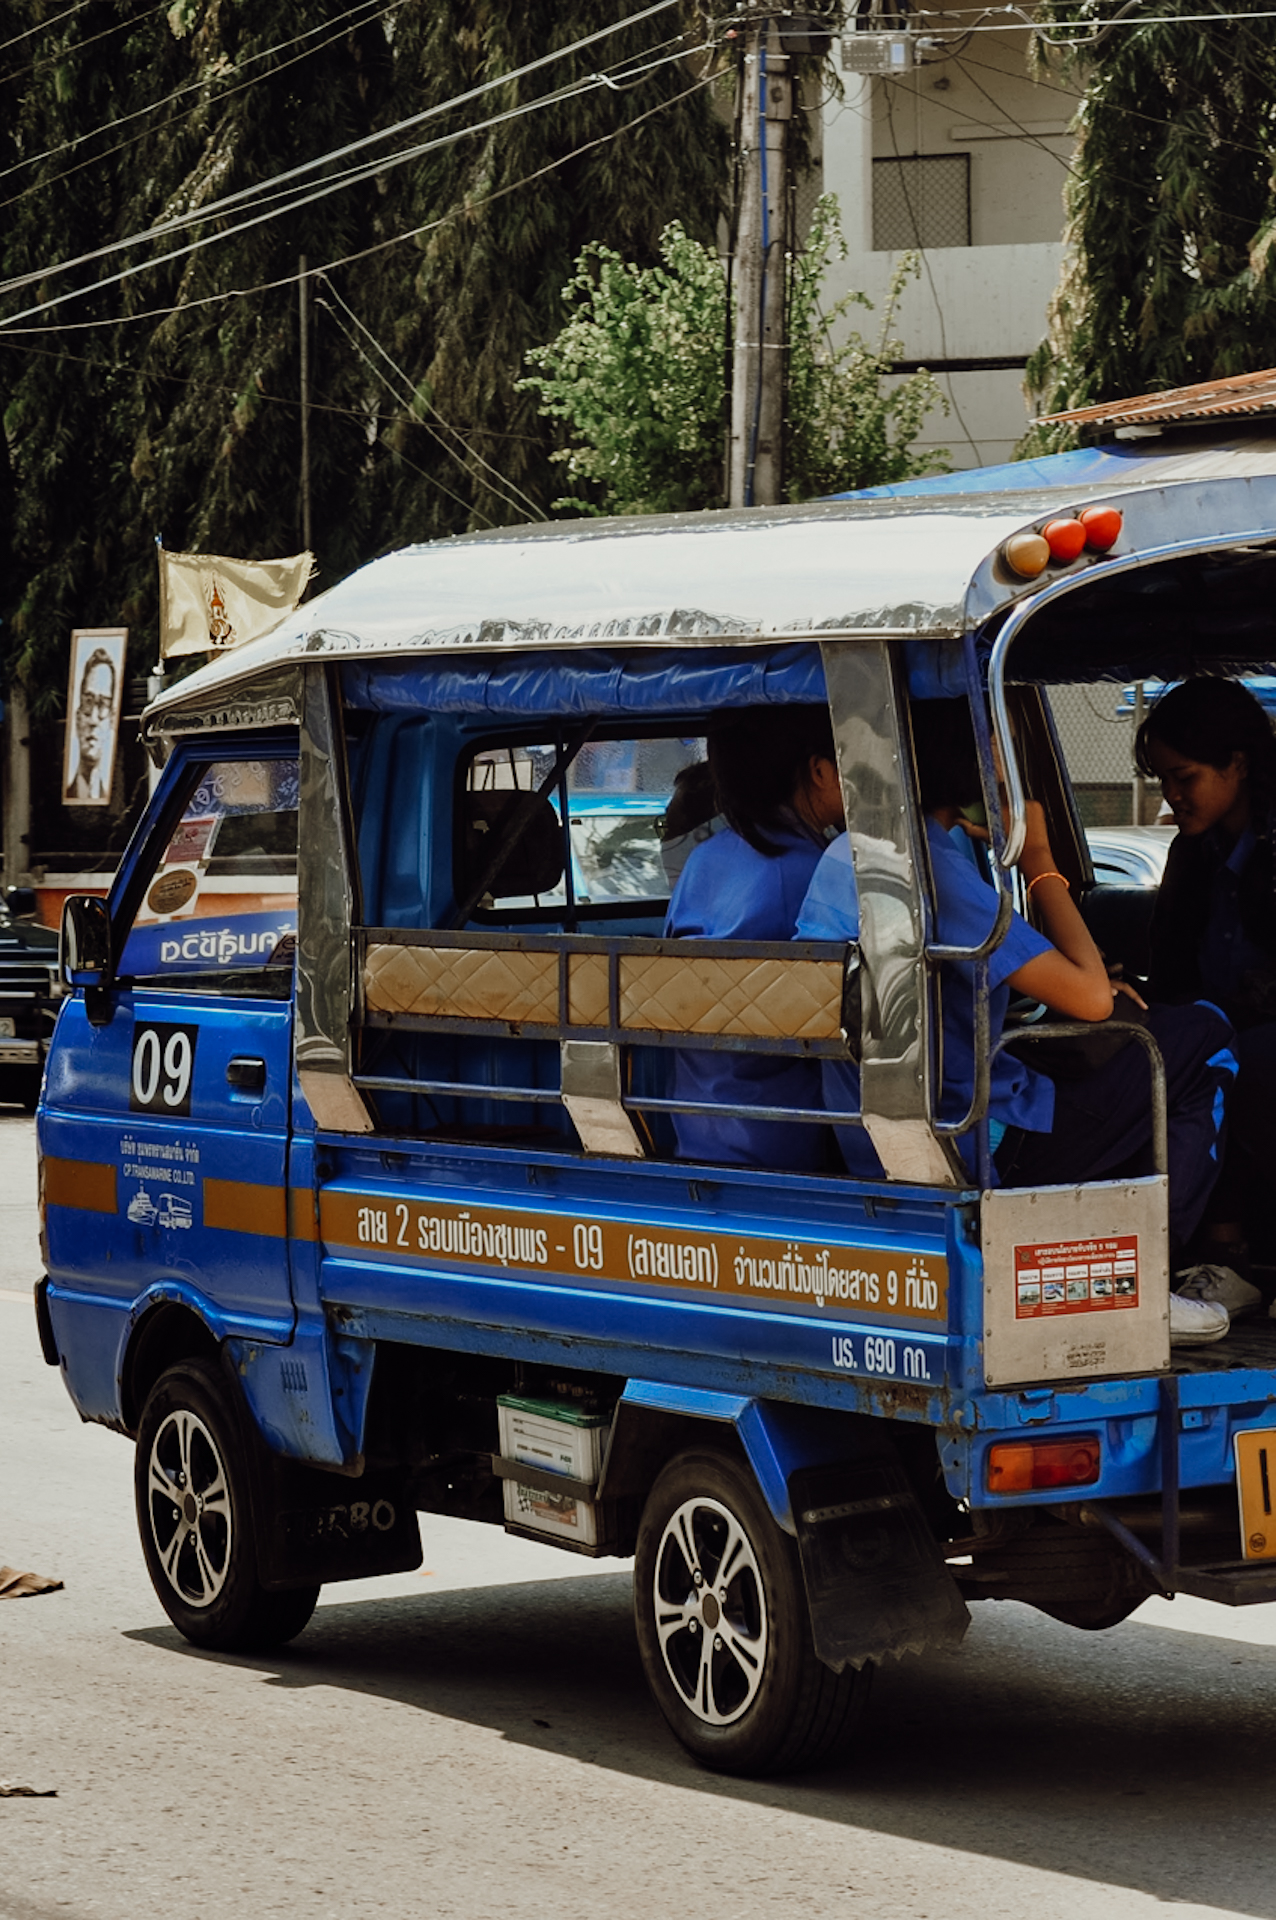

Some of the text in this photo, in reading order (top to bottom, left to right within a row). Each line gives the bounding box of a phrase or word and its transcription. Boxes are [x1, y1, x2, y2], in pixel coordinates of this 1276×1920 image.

[133, 1030, 191, 1106] 09
[357, 1207, 388, 1244] สาย
[396, 1203, 409, 1247] 2
[418, 1211, 548, 1267] รอบเมืองชุมพร
[573, 1223, 604, 1270] 09
[627, 1233, 719, 1288] (สายนอก)
[734, 1243, 880, 1308] จำนวนที่นั่งผู้โดยสาร
[886, 1270, 898, 1306] 9
[905, 1257, 938, 1311] ที่นั่ง
[865, 1336, 896, 1375] 690
[903, 1346, 931, 1380] กก.
